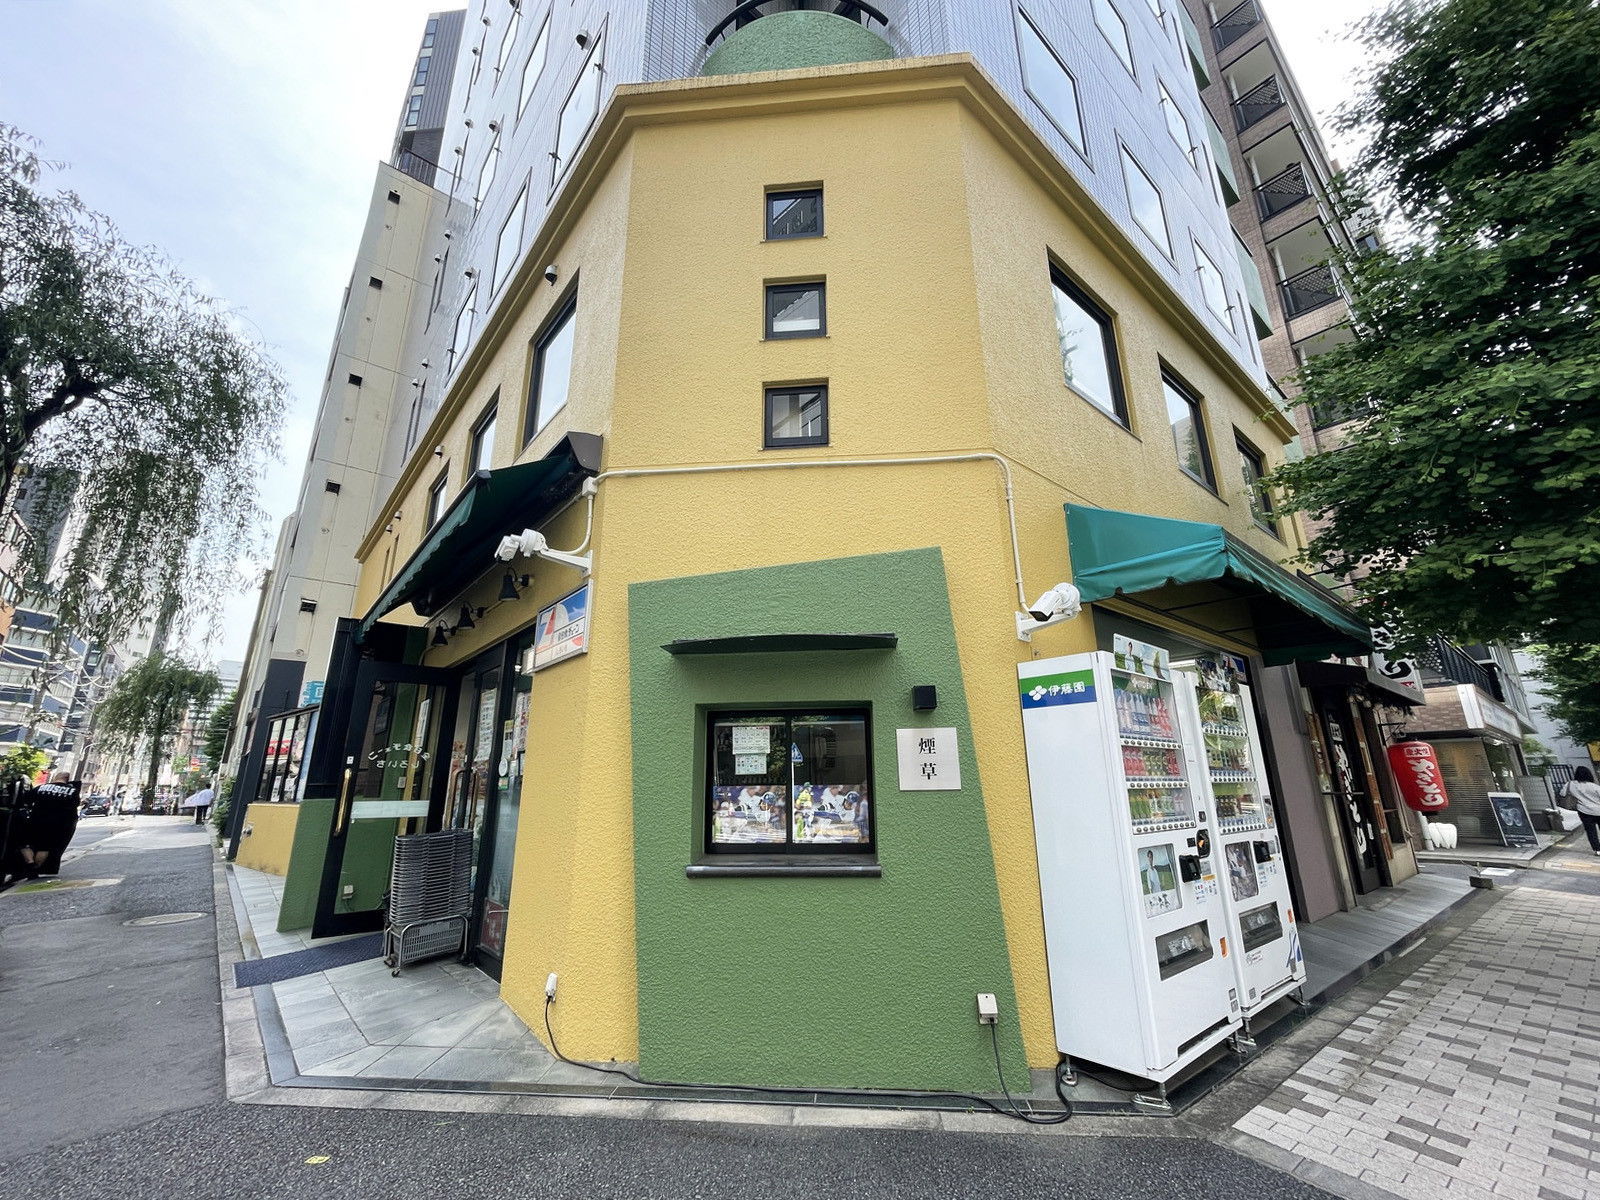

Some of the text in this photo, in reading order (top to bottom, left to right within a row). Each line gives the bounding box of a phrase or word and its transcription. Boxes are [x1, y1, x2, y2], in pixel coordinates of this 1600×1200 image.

[1048, 681, 1086, 697] 伊藤園
[917, 737, 938, 781] 煙草
